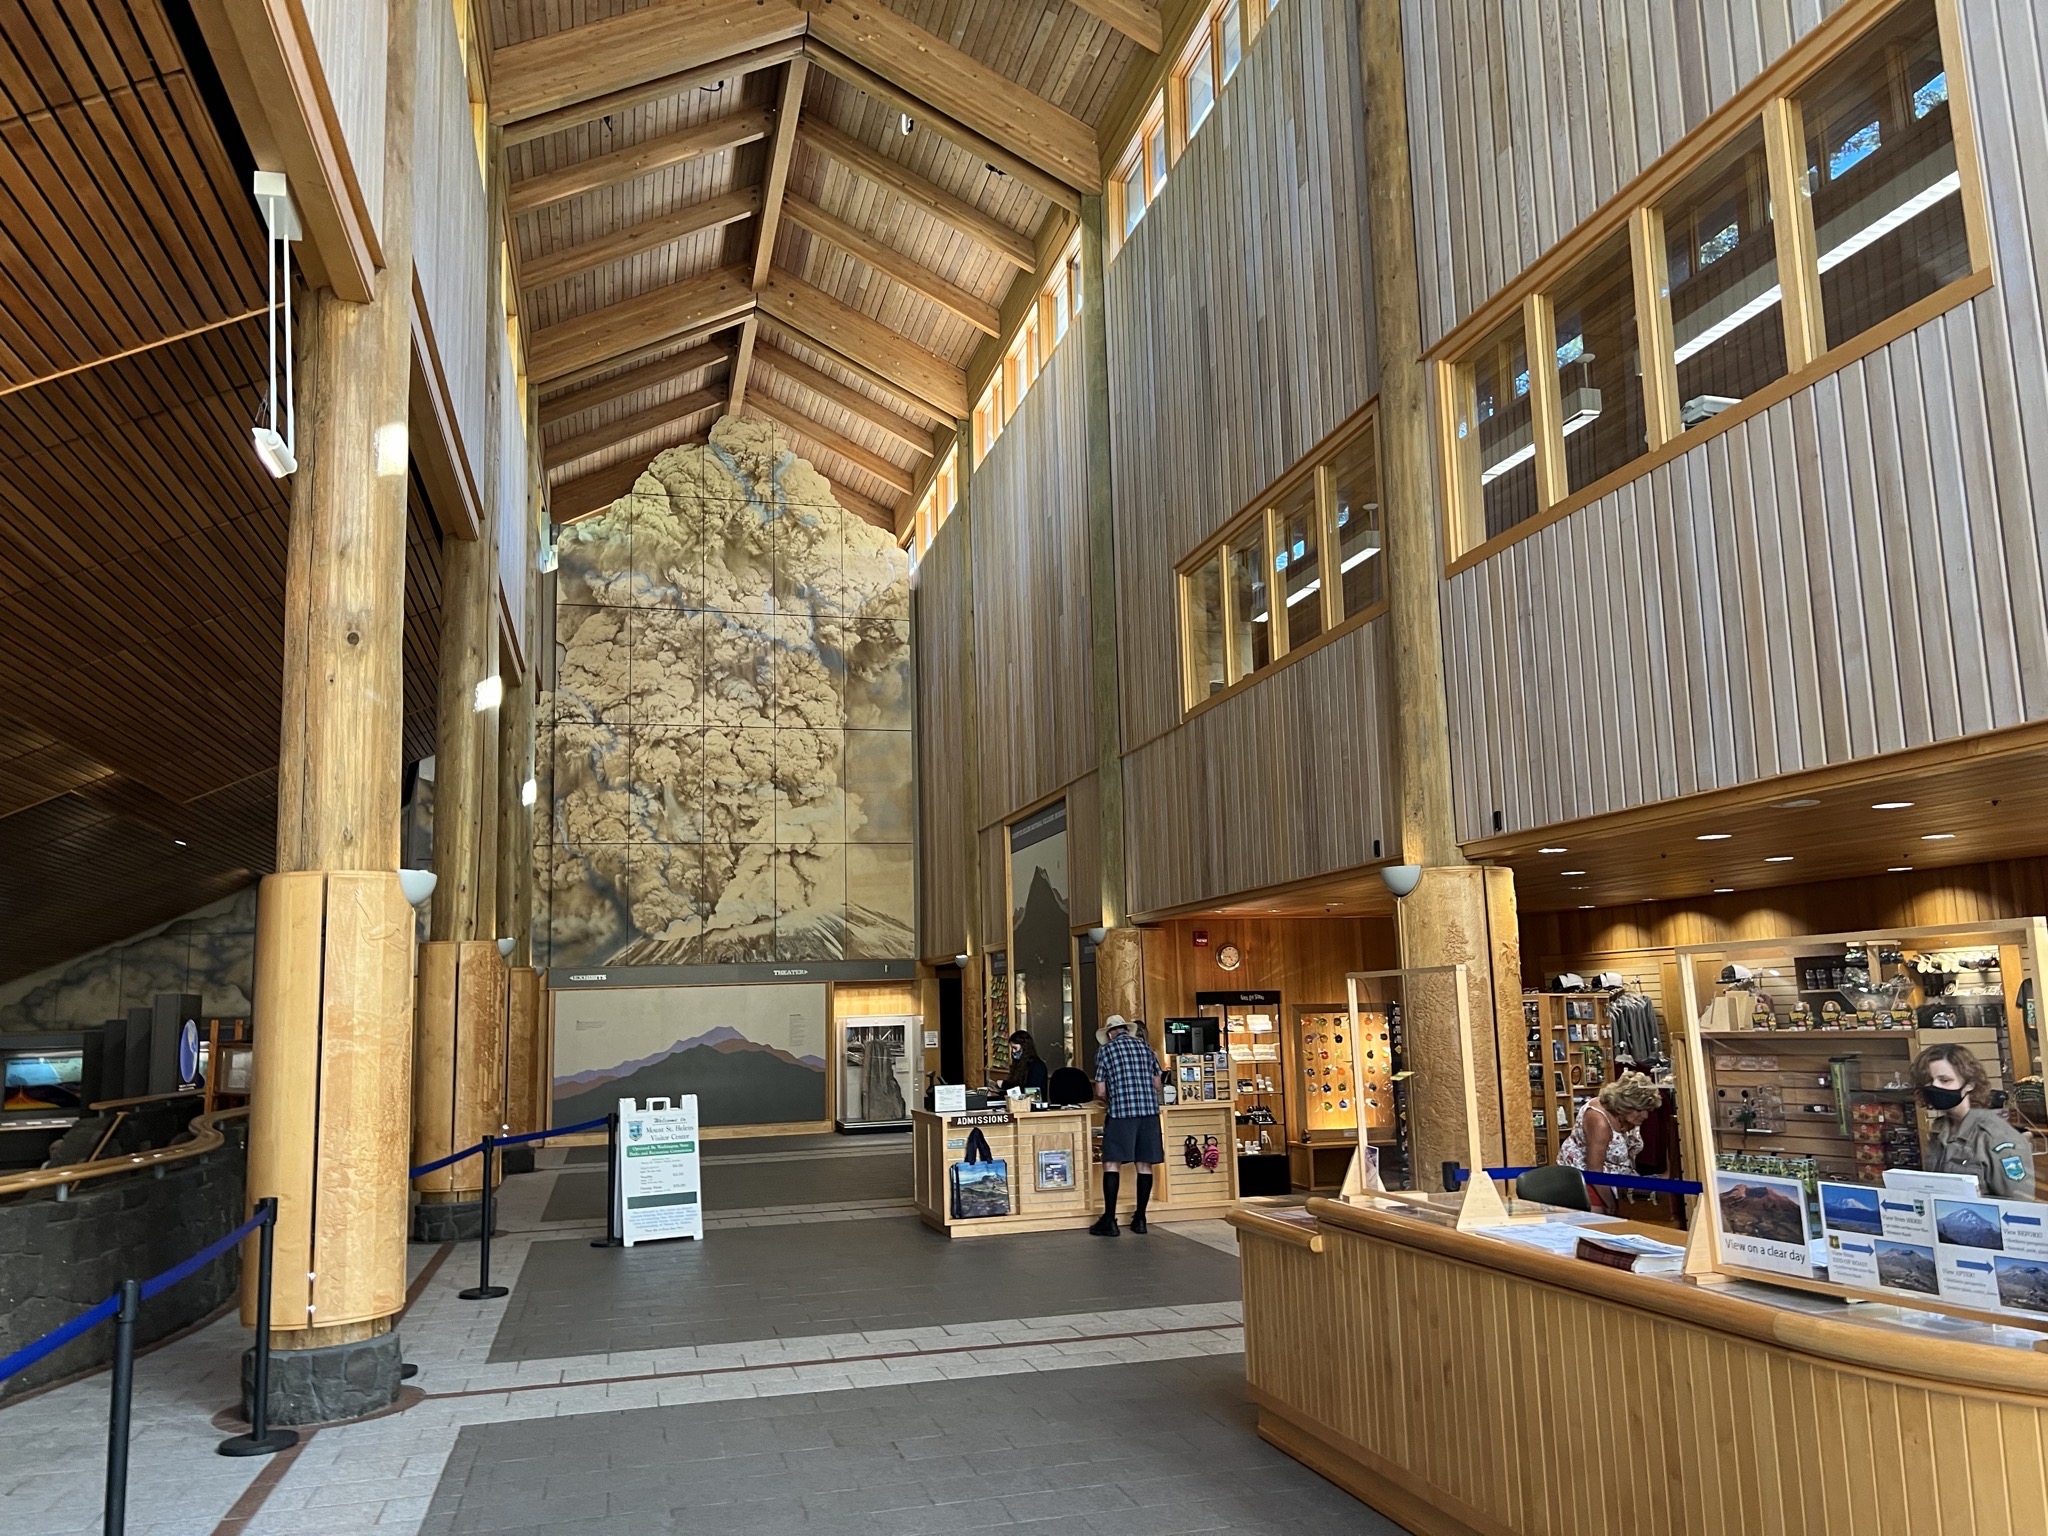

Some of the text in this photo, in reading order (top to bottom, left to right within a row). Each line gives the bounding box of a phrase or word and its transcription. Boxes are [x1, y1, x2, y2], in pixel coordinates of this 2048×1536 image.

[957, 1115, 1009, 1125] ADMISSIONS
[1725, 1239, 1805, 1264] View on a clear day
